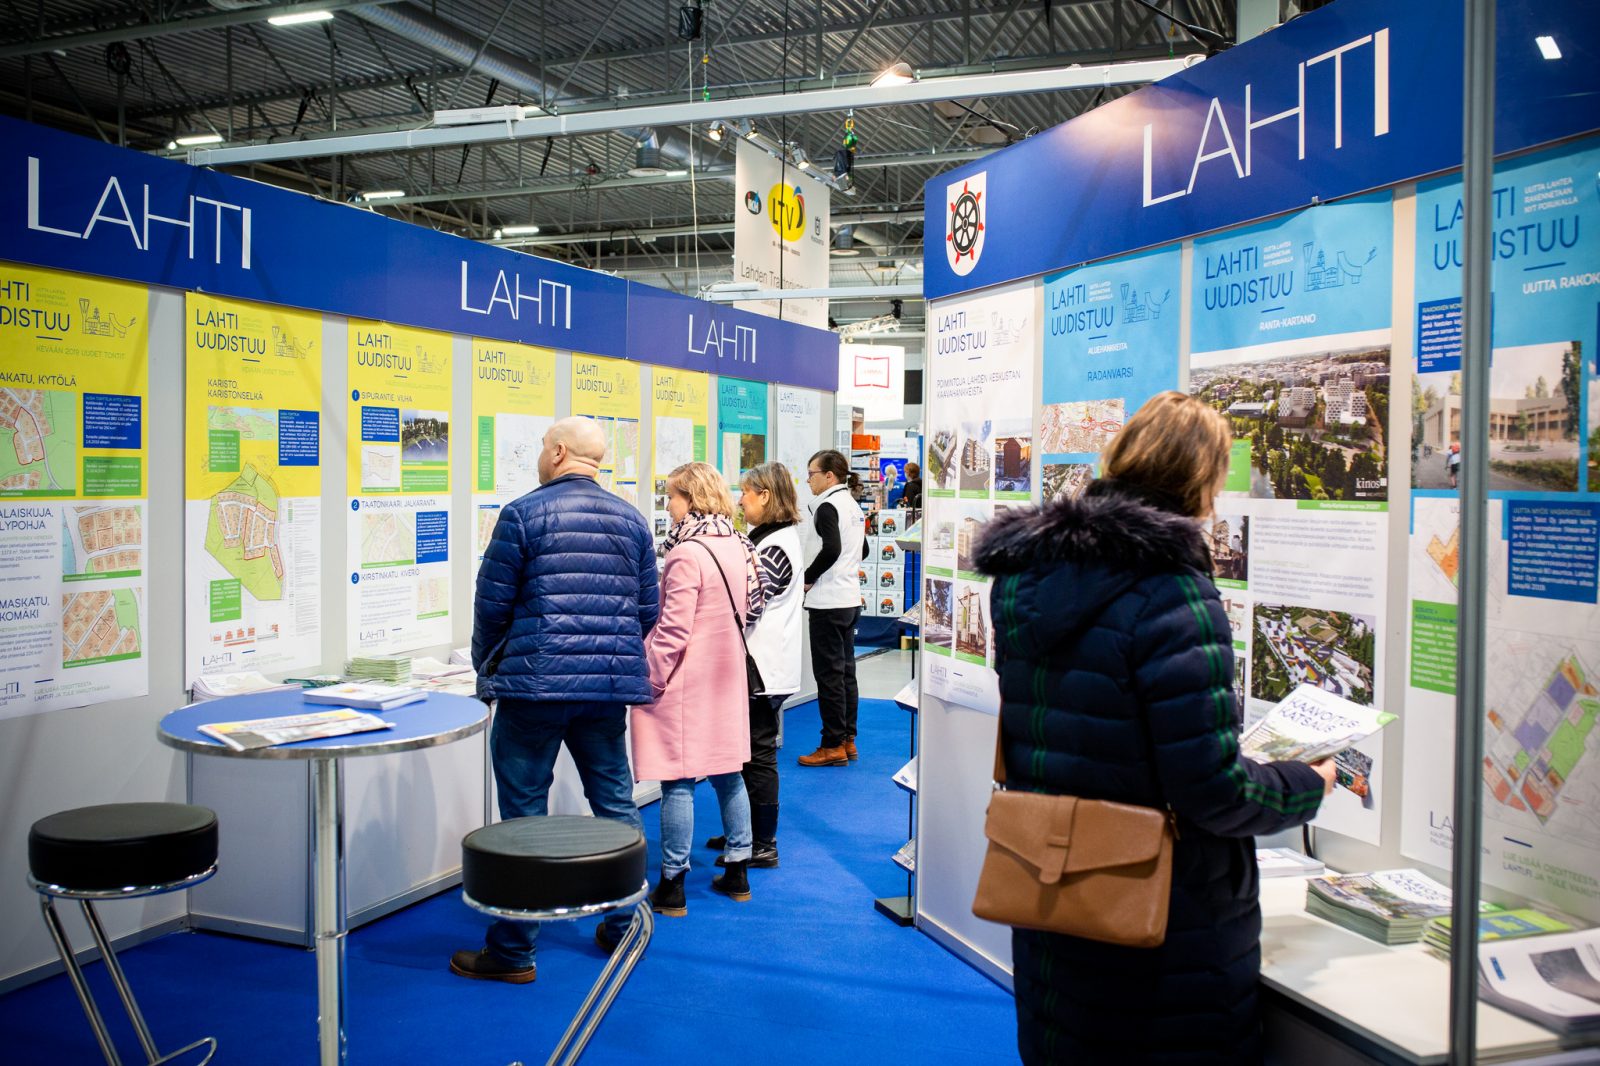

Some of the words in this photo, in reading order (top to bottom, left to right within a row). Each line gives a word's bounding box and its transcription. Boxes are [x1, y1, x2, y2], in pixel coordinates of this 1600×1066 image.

[1143, 28, 1389, 208] LAHTI
[28, 156, 251, 269] LAHTI
[1436, 186, 1515, 232] LATI
[1434, 215, 1579, 270] UUISTUU
[741, 261, 768, 284] Lahden
[1206, 246, 1258, 280] LAHTI
[0, 280, 29, 301] HTI
[1205, 271, 1294, 310] UUDISTUU
[1523, 280, 1558, 294] UUTTA
[1560, 272, 1600, 289] RAKOK
[462, 260, 571, 329] LAHTI
[1052, 284, 1086, 310] LAHTI
[0, 305, 70, 332] DISTUU
[196, 308, 238, 330] LAHTI
[938, 312, 966, 332] LAHTI
[1052, 306, 1114, 336] UUDISTUU
[1259, 313, 1316, 331] RANTA-KARTANO
[196, 331, 266, 355] UUDISTUU
[358, 332, 392, 350] LAHTI
[688, 314, 757, 363] LAHTI
[938, 330, 986, 355] UUDISTUU
[358, 351, 412, 370] UUDISTUU
[478, 349, 506, 365] LAHTI
[478, 367, 524, 384] UUDISTUU
[576, 362, 598, 376] LAHTI
[1088, 368, 1134, 382] RADANVARSI
[0, 371, 35, 385] AKATU,
[38, 372, 77, 387] KYTÖLÄ
[576, 379, 612, 394] UUDISTUU
[656, 376, 674, 388] LAHTI
[656, 389, 684, 402] UUDISTUU
[1356, 478, 1380, 488] kinos
[0, 508, 53, 519] ALAISKUJA,
[0, 520, 46, 531] LYPOHJA
[0, 597, 50, 609] MASKATU,
[0, 608, 39, 621] KOMÄKI
[360, 630, 384, 640] LAHTI
[203, 652, 232, 666] LAHTI
